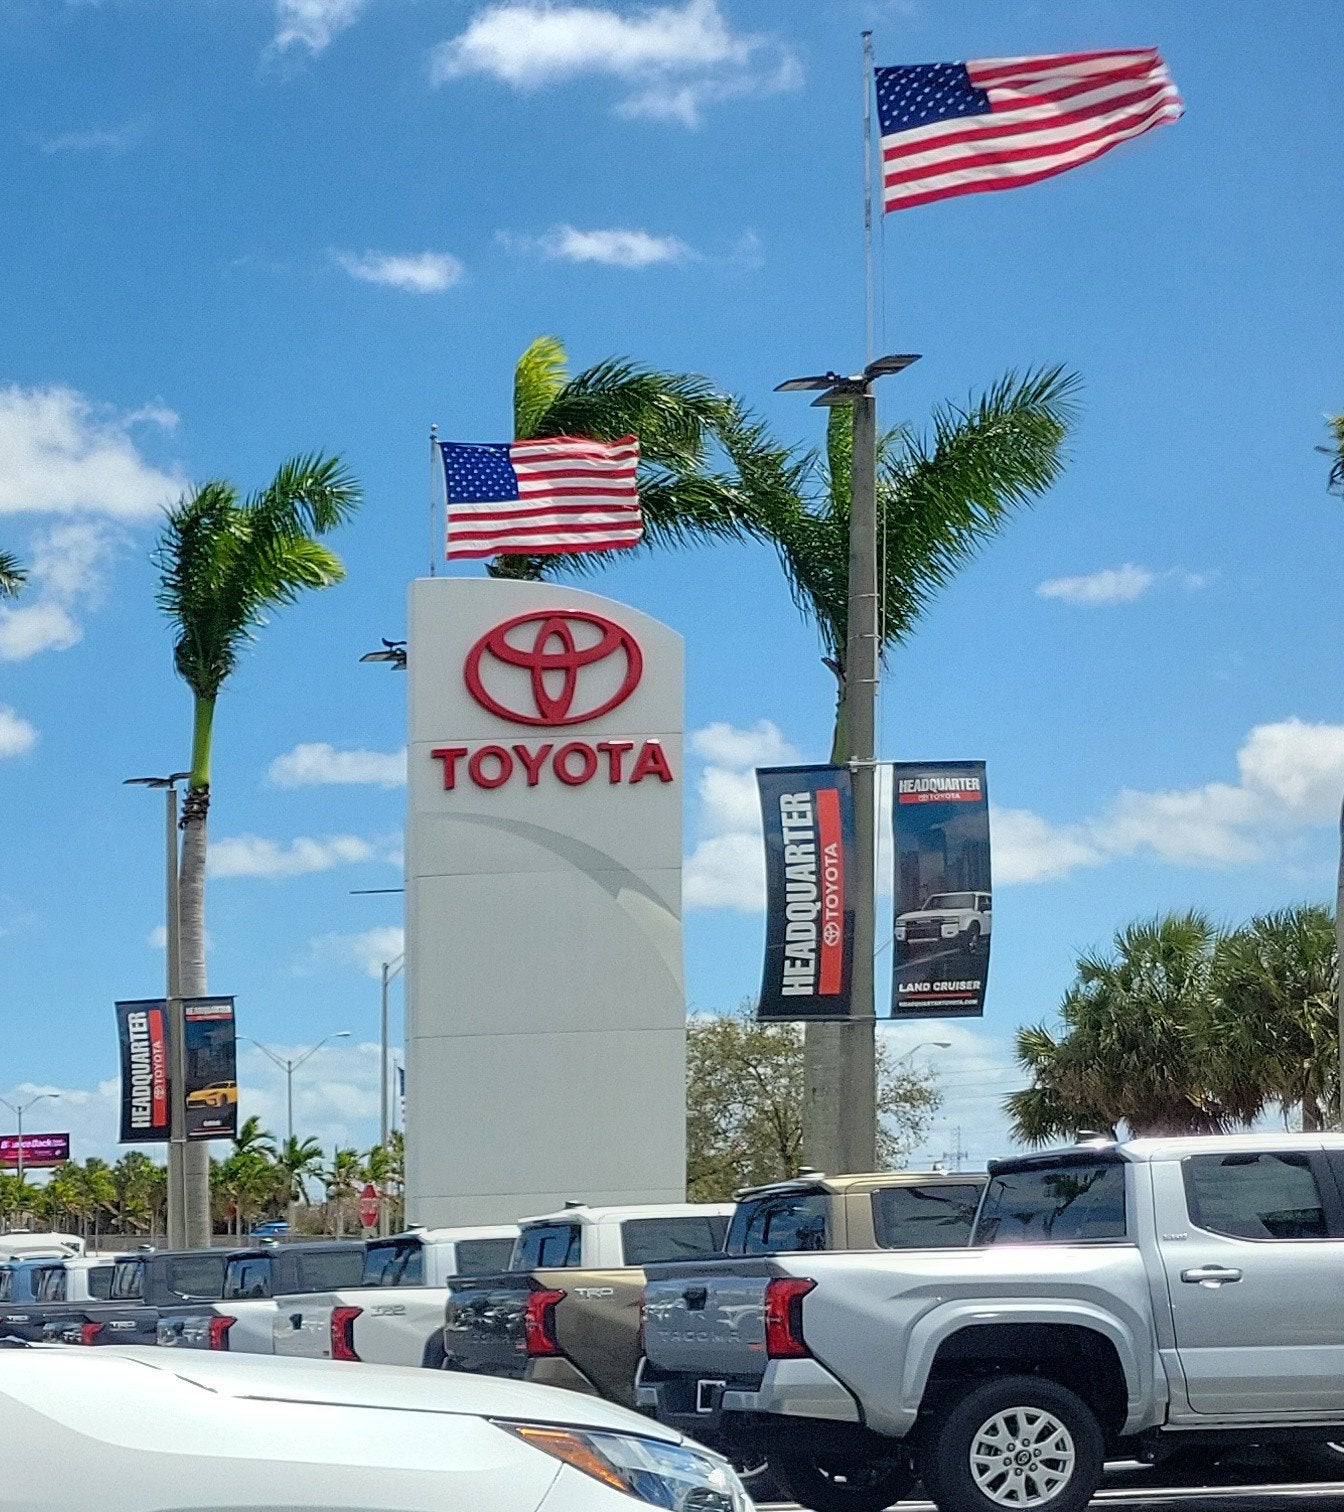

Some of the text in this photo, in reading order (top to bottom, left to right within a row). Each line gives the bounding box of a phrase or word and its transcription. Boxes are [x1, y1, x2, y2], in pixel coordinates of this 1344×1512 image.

[431, 739, 673, 790] TOYOTA
[899, 777, 980, 793] HEADQUARTER
[779, 792, 822, 996] HEADQUARTER
[824, 843, 839, 920] TOYOTA
[899, 981, 981, 993] LAND CRUISER
[127, 1011, 153, 1129] HEADQUARTER
[152, 1040, 163, 1086] TOYOTA
[574, 1287, 614, 1298] TRD
